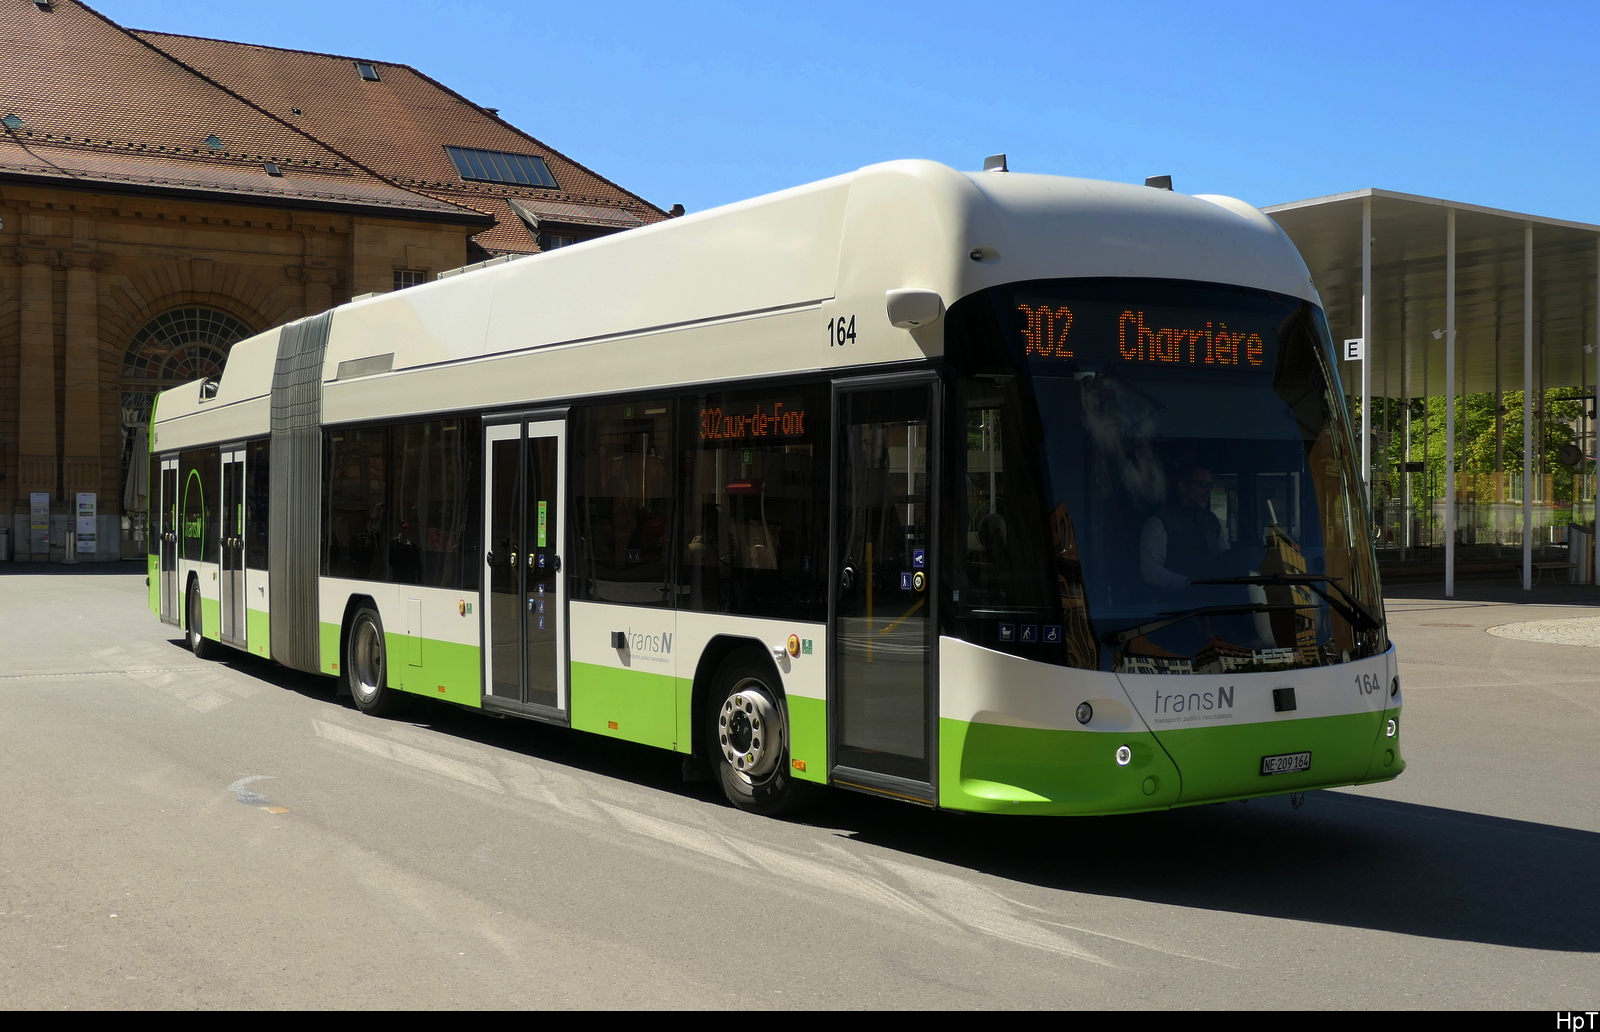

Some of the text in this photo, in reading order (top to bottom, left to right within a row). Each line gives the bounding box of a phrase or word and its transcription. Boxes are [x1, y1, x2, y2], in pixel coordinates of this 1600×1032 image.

[827, 314, 857, 347] 164
[1018, 304, 1263, 366] 302 Charrière
[1348, 341, 1359, 358] E
[626, 626, 673, 654] transN
[1354, 672, 1381, 696] 164
[1155, 686, 1234, 714] transN
[1183, 715, 1201, 723] publics
